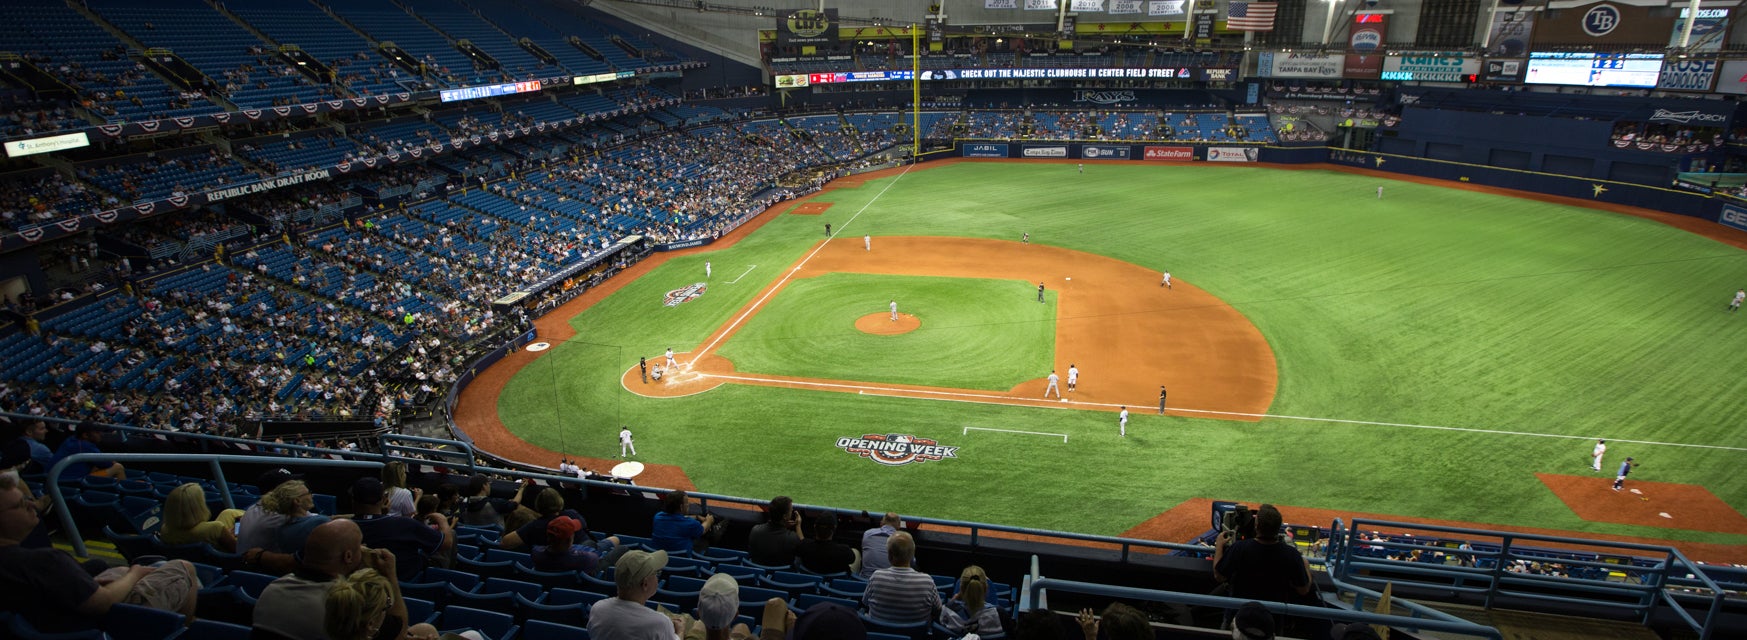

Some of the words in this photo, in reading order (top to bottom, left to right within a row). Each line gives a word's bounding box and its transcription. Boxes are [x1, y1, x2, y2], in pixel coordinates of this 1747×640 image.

[1680, 8, 1728, 18] MOSE.COM
[1603, 60, 1611, 68] 2
[1615, 60, 1624, 69] 2
[961, 69, 982, 78] CHECK
[984, 69, 997, 78] OUT
[999, 69, 1011, 78] THE
[1013, 69, 1046, 77] MAJESTIC
[1047, 69, 1087, 77] CLUBHOUSE
[1088, 69, 1096, 77] IN
[1098, 69, 1124, 77] CENTER
[1126, 69, 1146, 77] FIELD
[1148, 68, 1174, 77] STREET
[1469, 73, 1477, 83] 4
[1660, 72, 1713, 89] RADIOLOGY
[206, 185, 252, 202] REPUBLIC
[251, 178, 277, 193] BANK
[276, 174, 305, 188] DRAFT
[304, 169, 330, 182] ROOM
[838, 437, 907, 453] OPENING
[909, 443, 958, 458] WEEK
